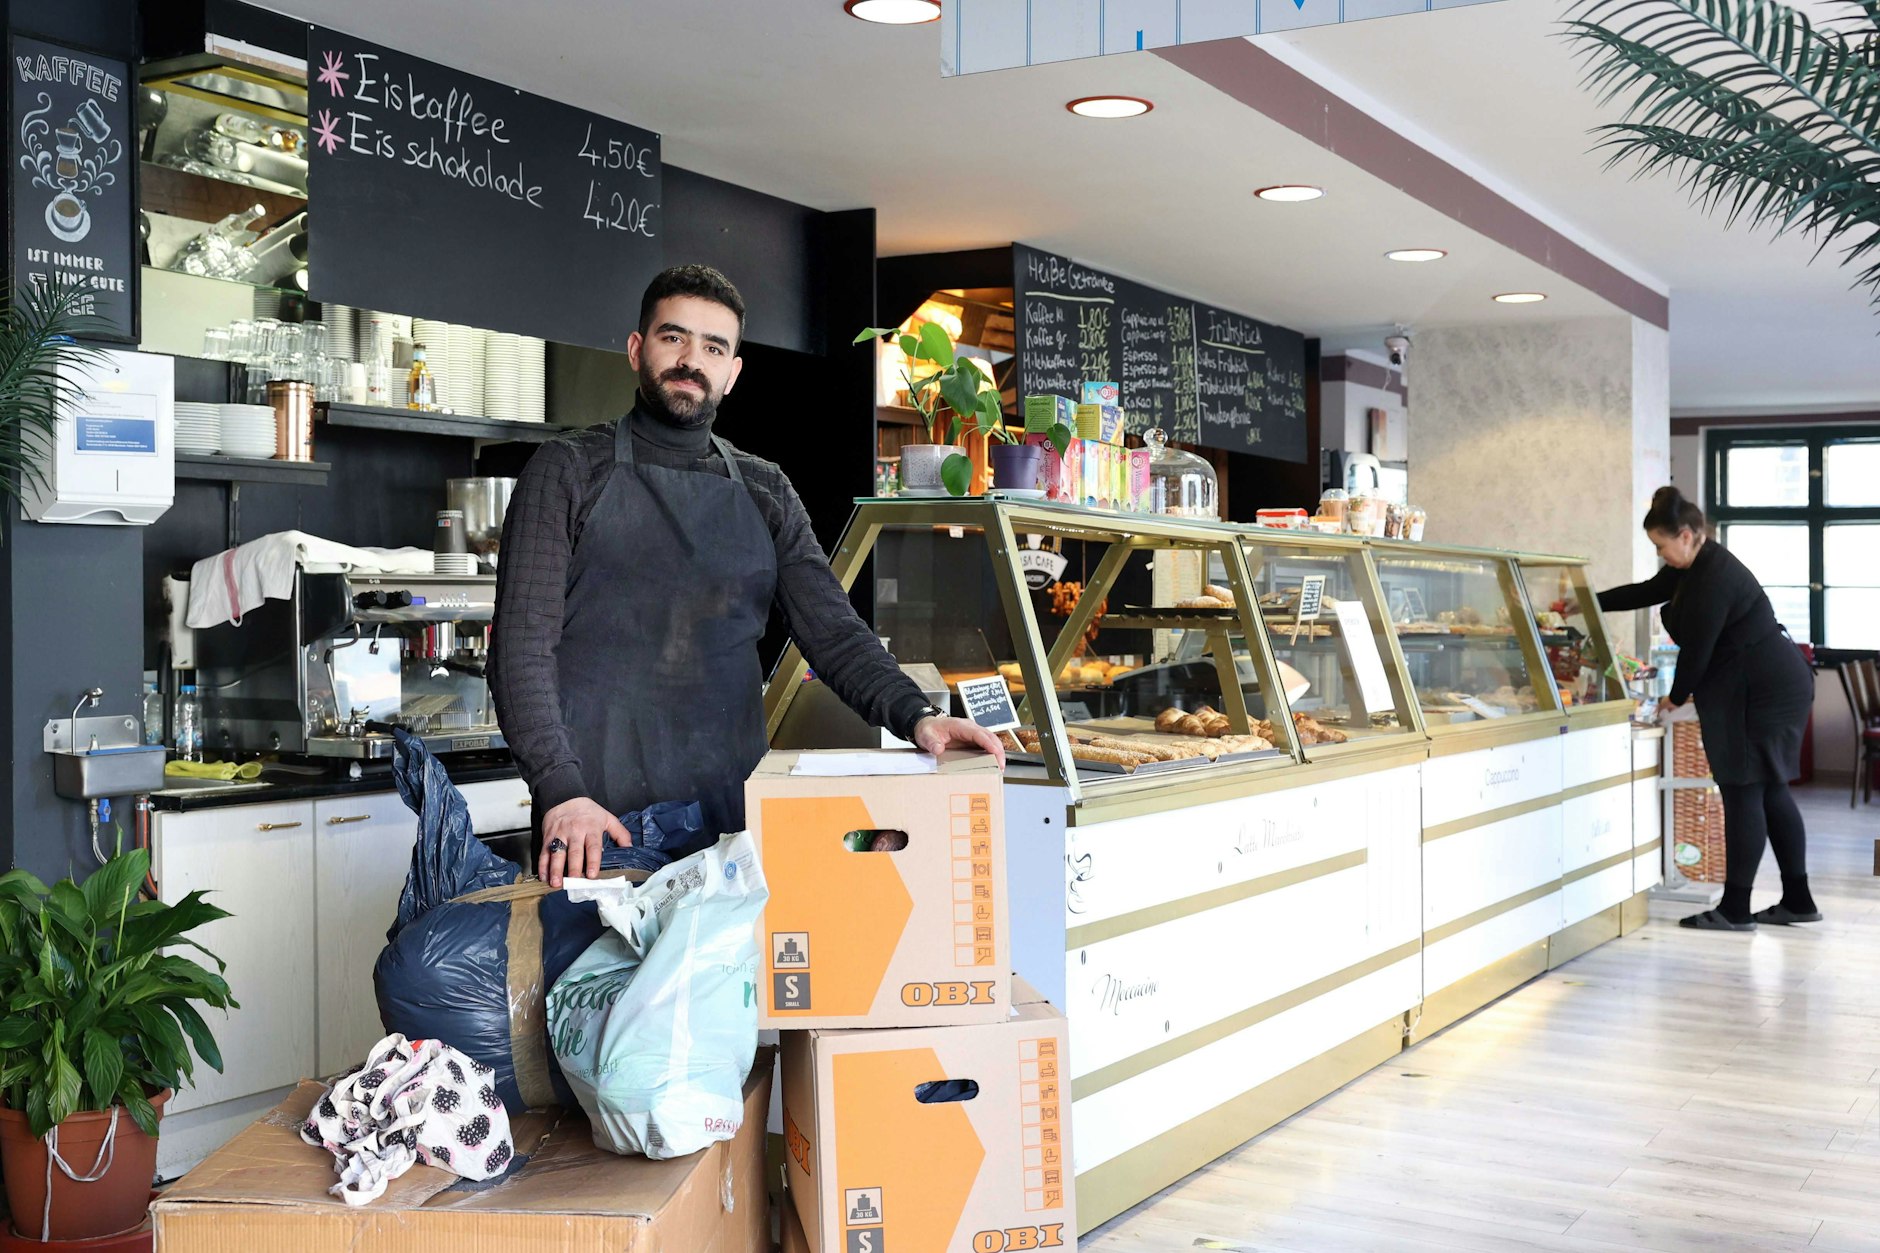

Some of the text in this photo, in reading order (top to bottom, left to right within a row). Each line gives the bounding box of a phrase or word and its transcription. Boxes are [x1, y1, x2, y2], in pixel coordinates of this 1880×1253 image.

[16, 54, 121, 102] KAFFEE
[354, 53, 510, 143] Eiskaffee
[578, 123, 654, 177] 4,50€
[583, 179, 655, 237] 4,20€
[28, 248, 104, 271] IST IMMER
[90, 276, 125, 292] GUTE
[1026, 300, 1054, 326] Kaffee
[1026, 327, 1054, 349] Kaffee
[785, 975, 799, 999] S
[901, 980, 995, 1007] OBI
[859, 1231, 873, 1253] S
[973, 1223, 1064, 1253] OBI
